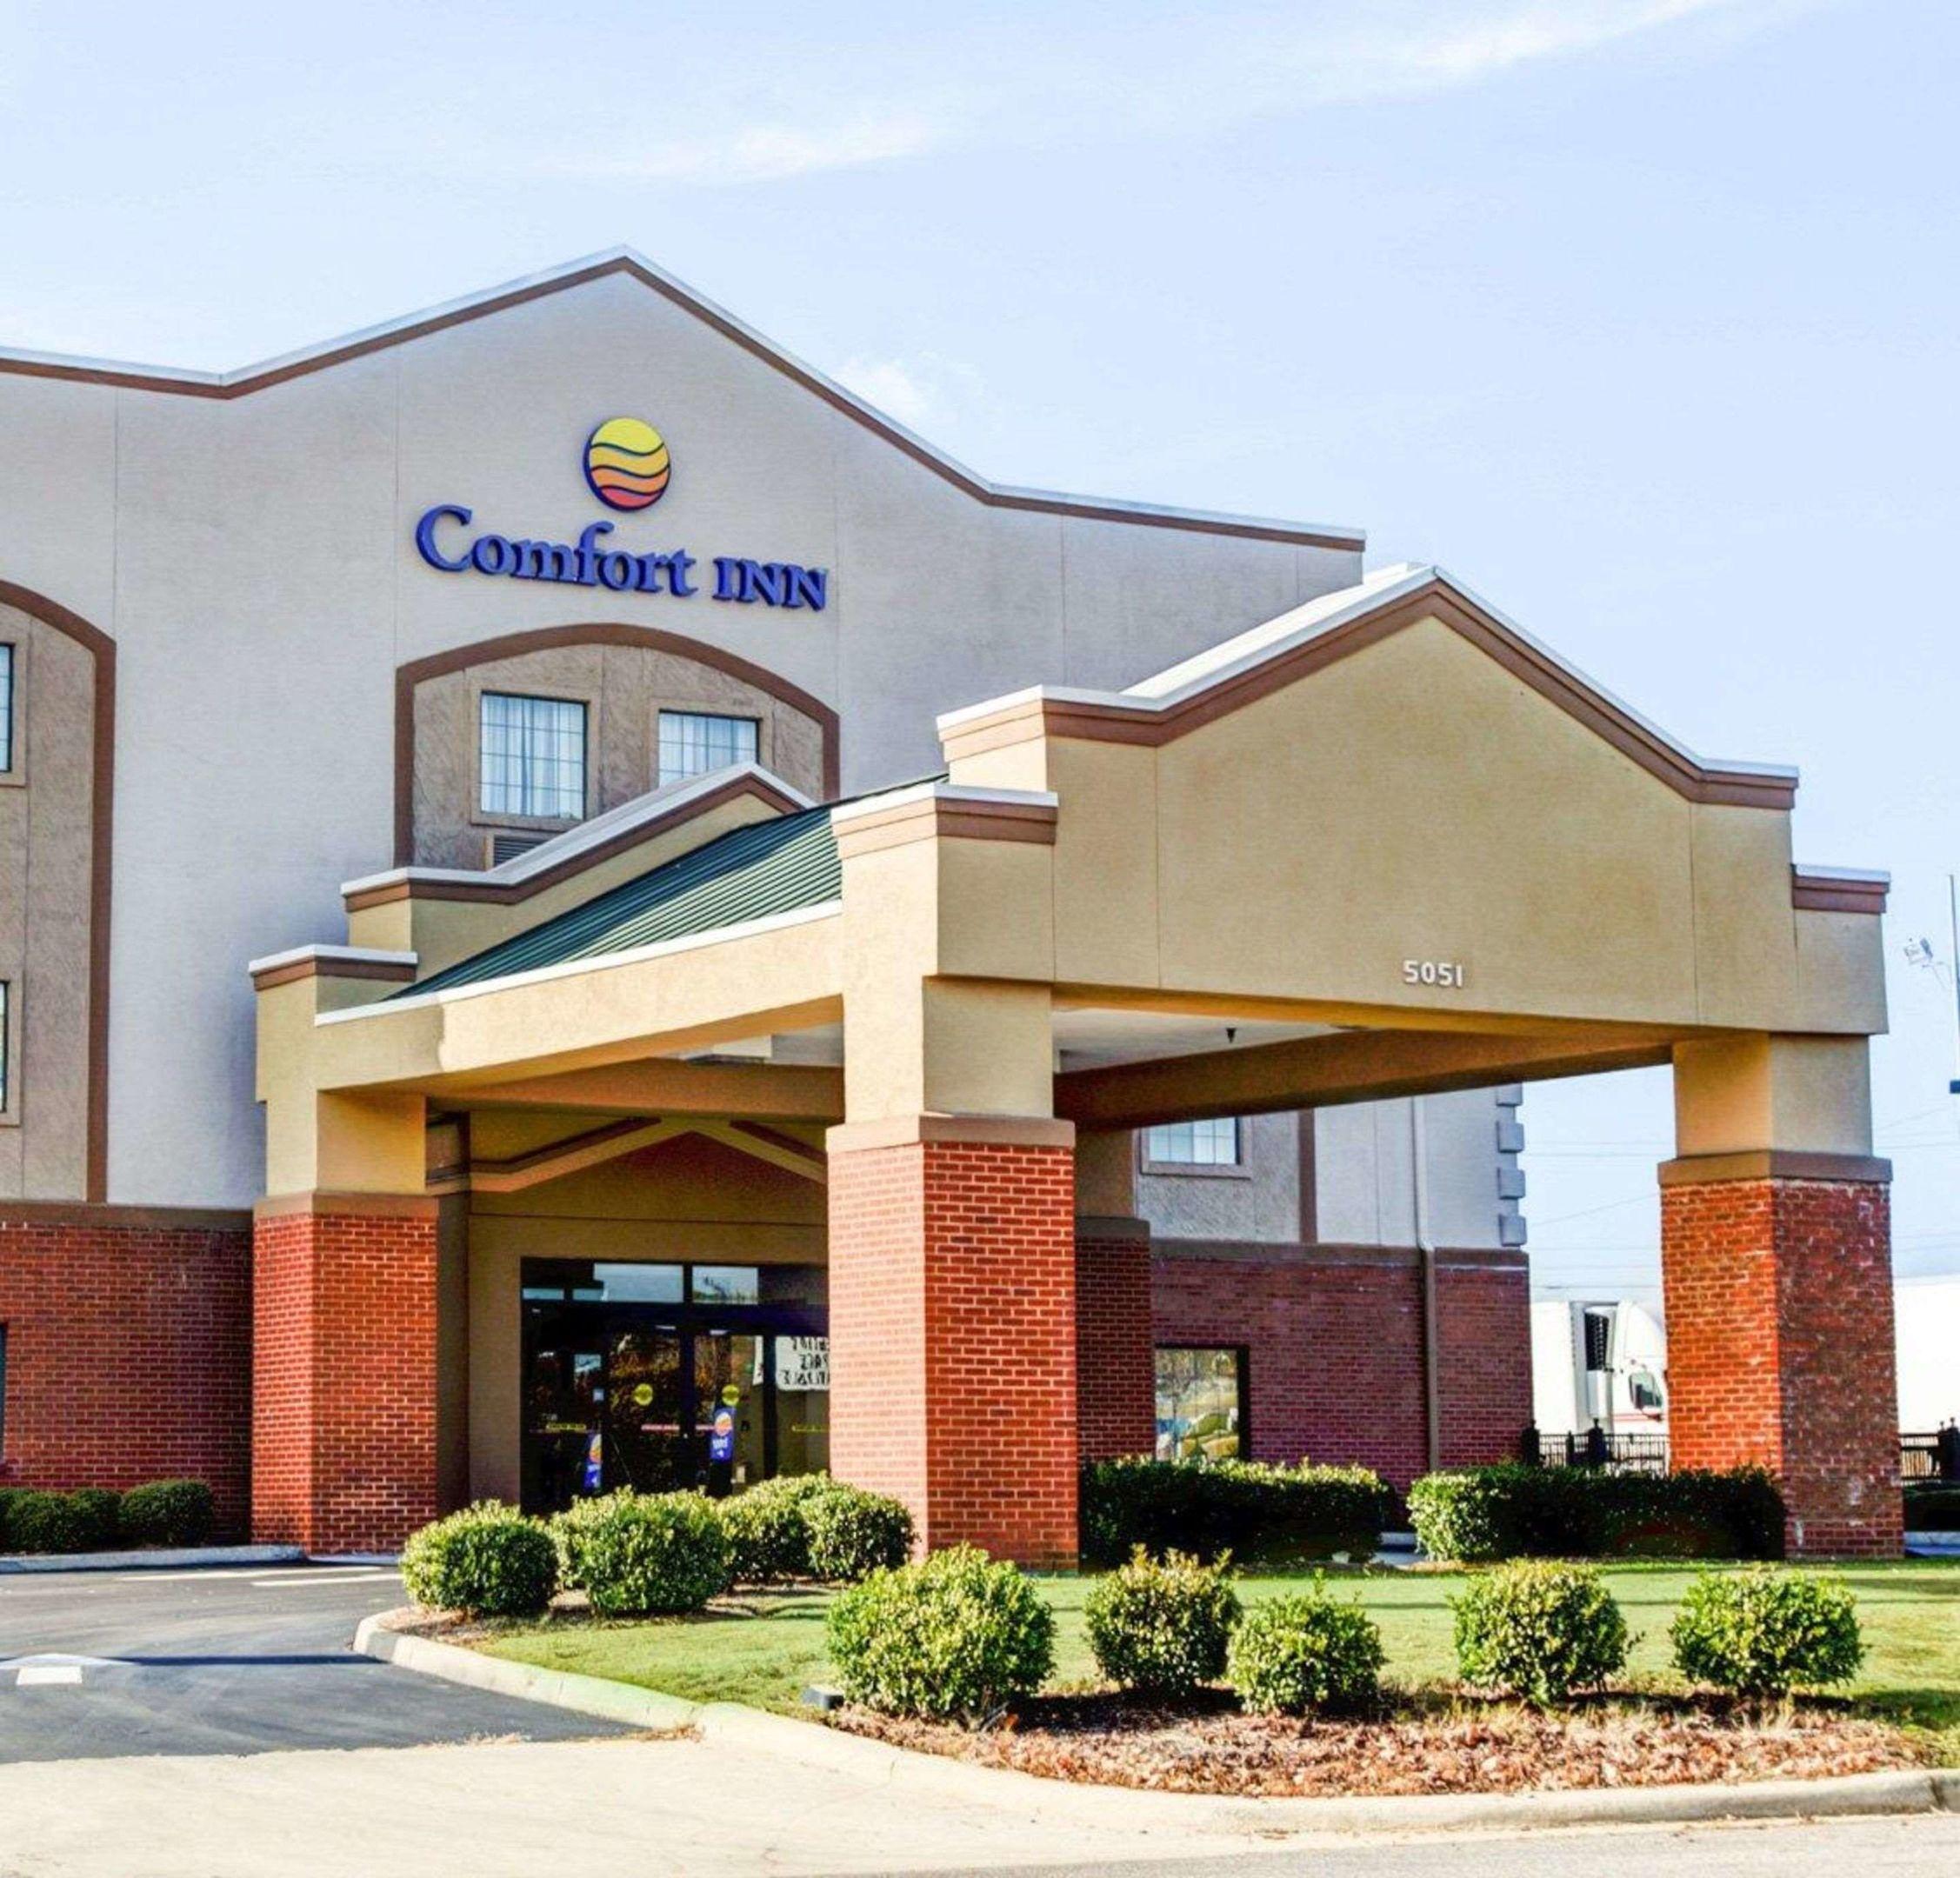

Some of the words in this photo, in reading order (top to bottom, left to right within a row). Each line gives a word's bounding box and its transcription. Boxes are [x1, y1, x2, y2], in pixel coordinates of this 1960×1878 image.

[416, 504, 698, 596] Comfort
[712, 556, 828, 611] INN
[1403, 959, 1463, 988] 5051
